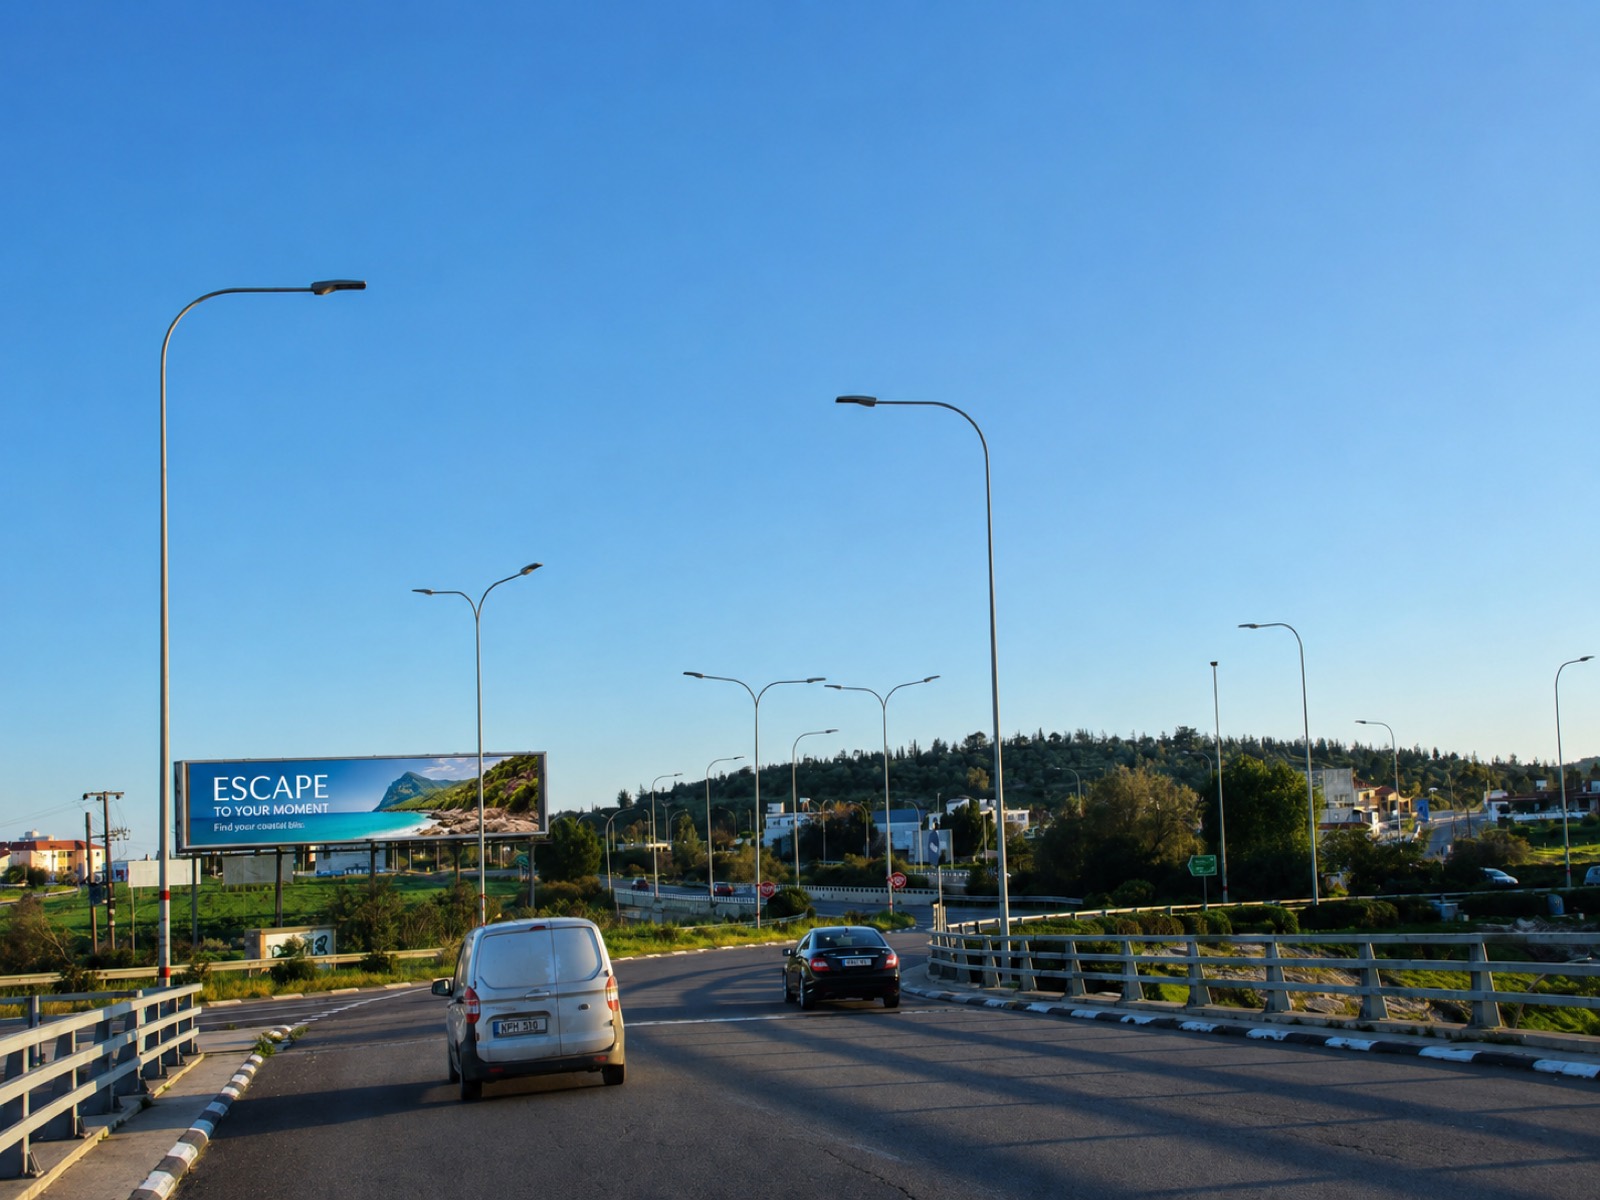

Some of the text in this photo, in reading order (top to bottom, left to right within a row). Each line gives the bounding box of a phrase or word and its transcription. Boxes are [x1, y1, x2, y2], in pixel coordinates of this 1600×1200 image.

[213, 774, 329, 801] ESCAPE
[213, 803, 329, 817] TO YOUR MOMENT
[213, 822, 233, 832] Find
[234, 823, 255, 833] your
